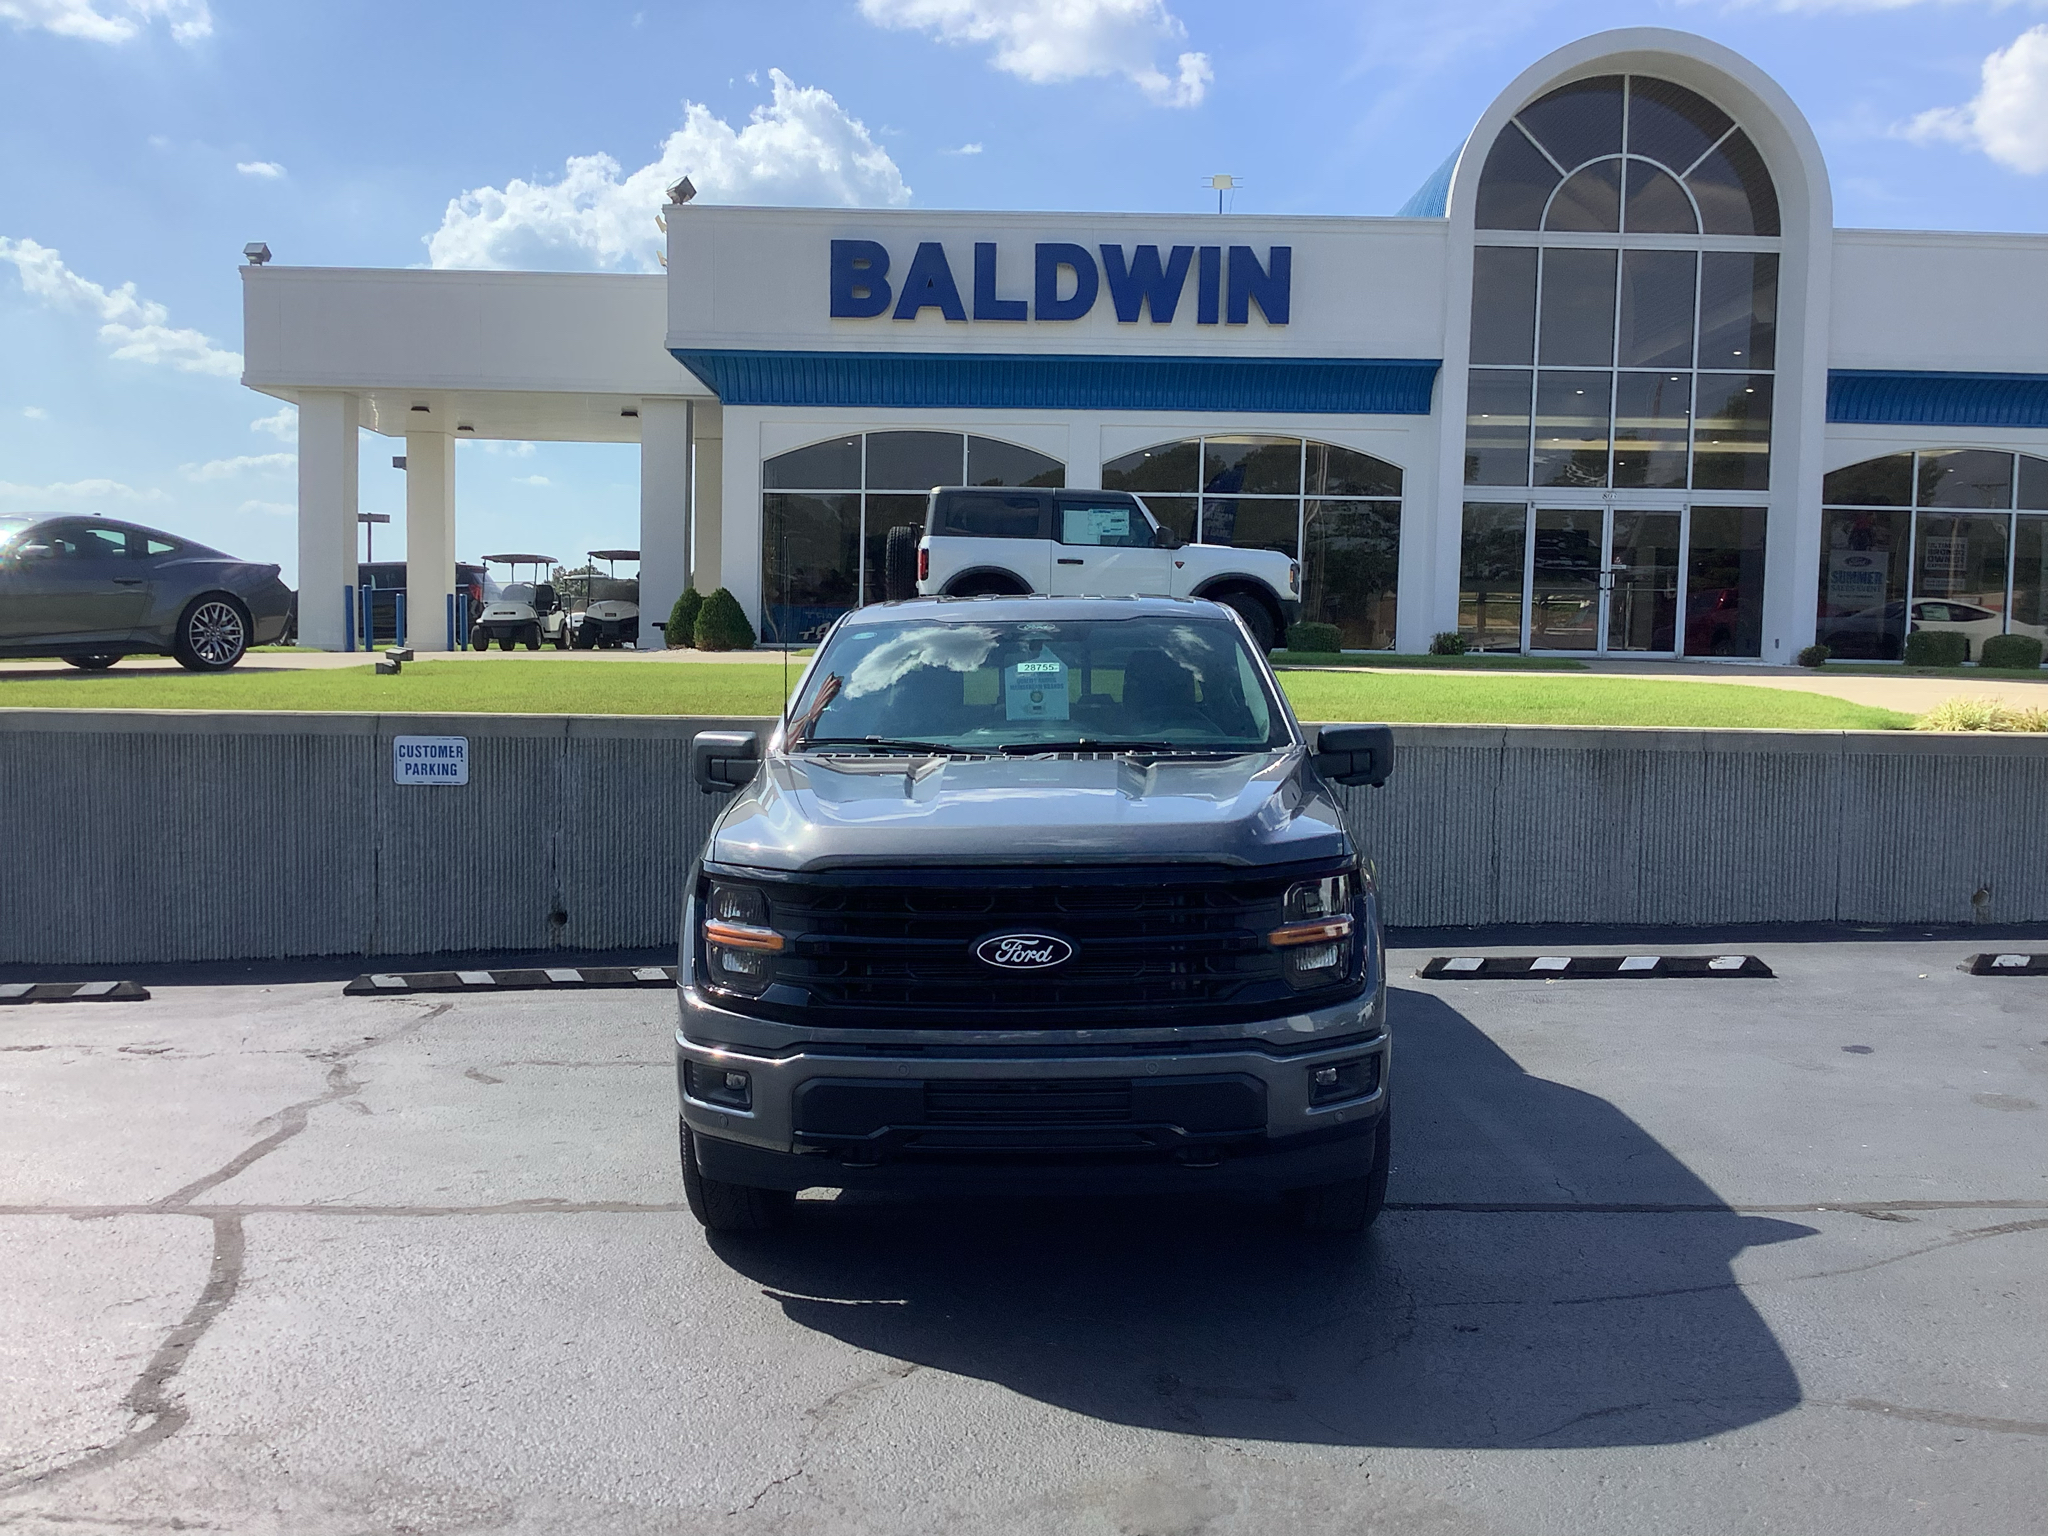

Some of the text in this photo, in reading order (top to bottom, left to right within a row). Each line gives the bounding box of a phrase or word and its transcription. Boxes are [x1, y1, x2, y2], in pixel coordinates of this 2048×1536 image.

[830, 239, 1292, 326] BALDWIN
[1830, 570, 1883, 585] SUMMER
[1857, 585, 1881, 593] EVENT
[399, 744, 463, 758] CUSTOMER
[405, 762, 458, 776] PARKING
[995, 938, 1054, 963] Ford
